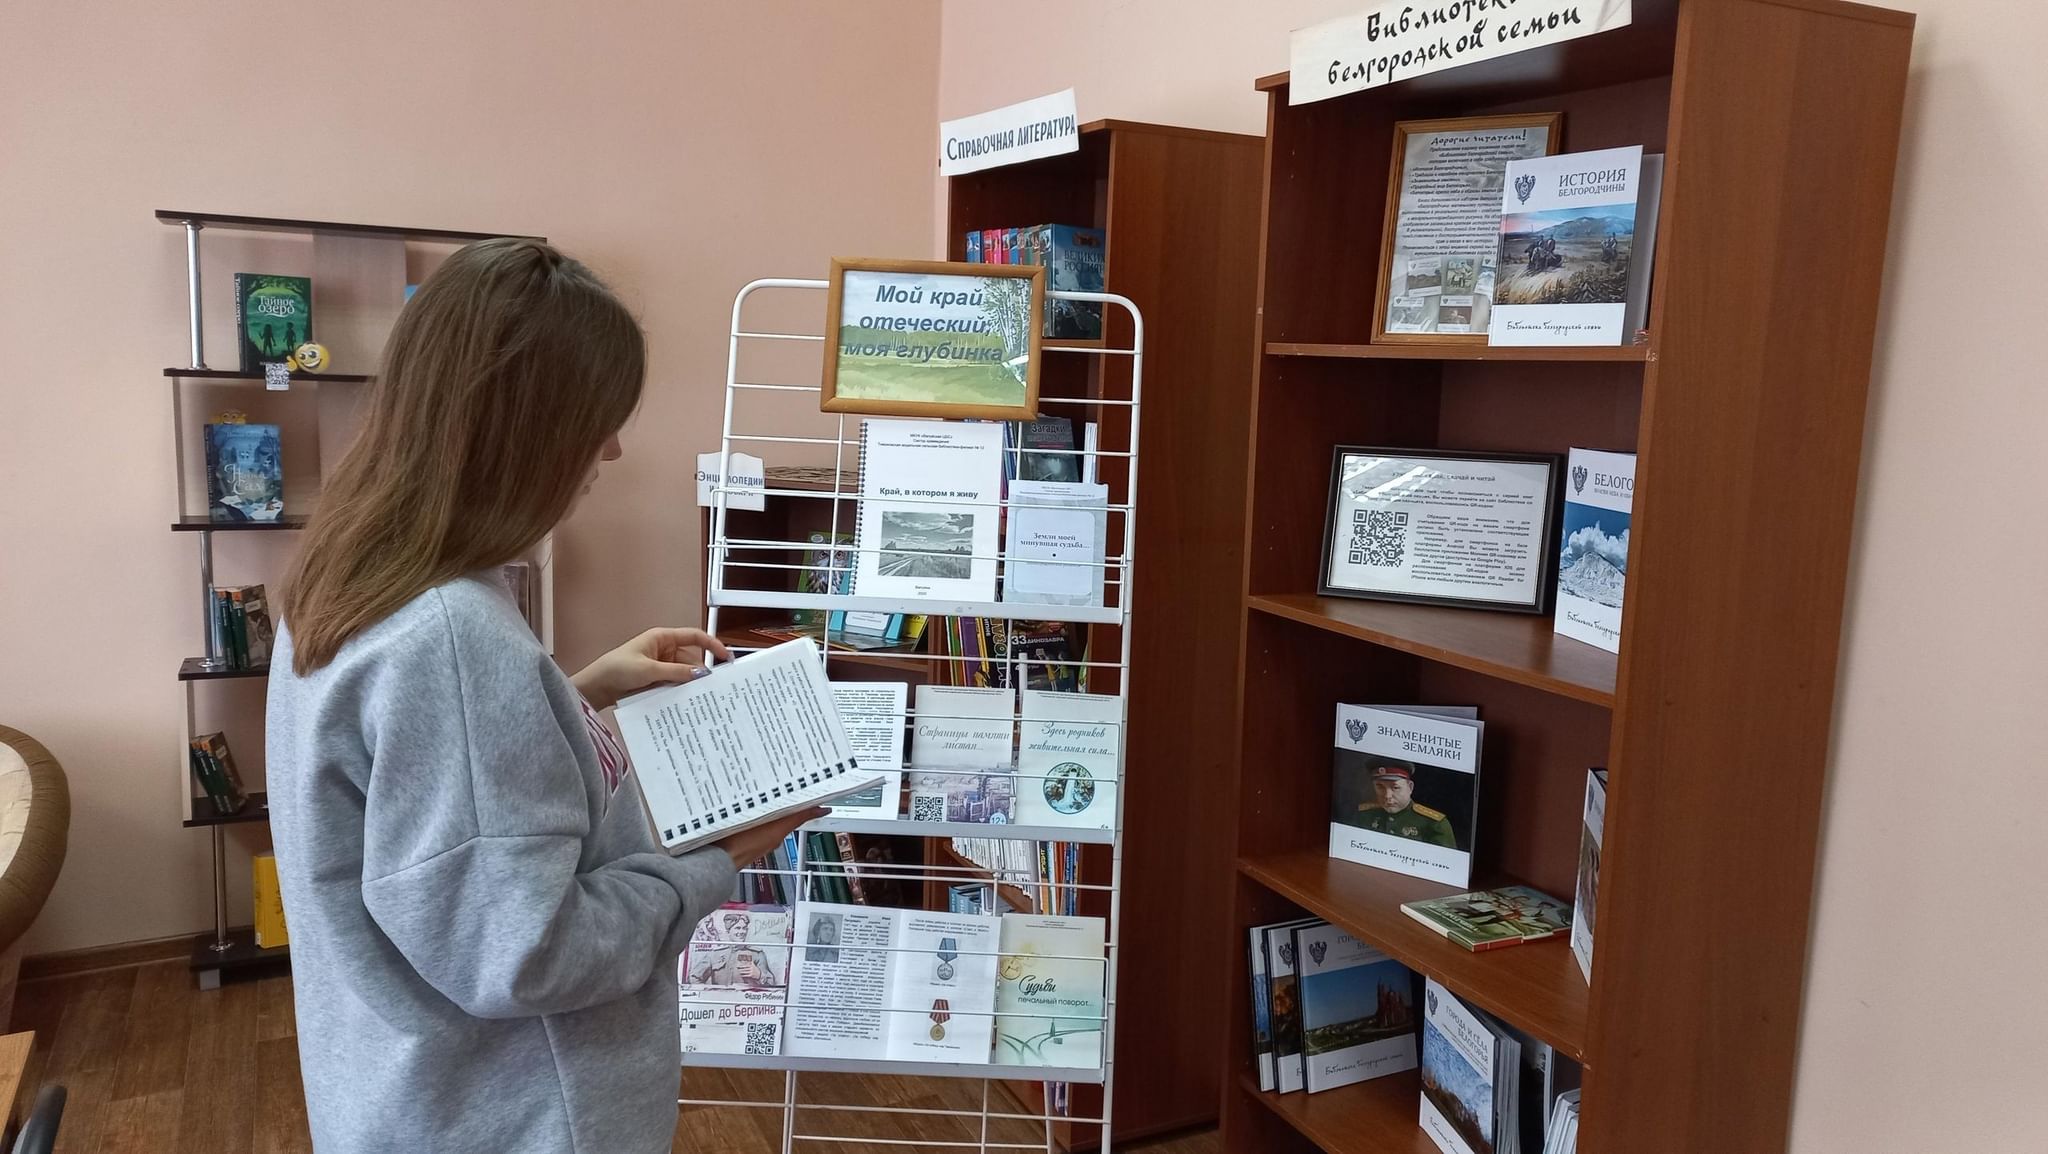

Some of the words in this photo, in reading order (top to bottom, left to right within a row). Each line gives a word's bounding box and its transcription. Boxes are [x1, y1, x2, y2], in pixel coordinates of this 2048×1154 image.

[1367, 0, 1515, 42] Библиотек
[1328, 18, 1488, 84] белгородской
[1497, 6, 1581, 42] семьи
[1017, 114, 1075, 146] ЛИТЕРАТУРА
[1559, 169, 1626, 187] ИСТОРИЯ
[1558, 183, 1626, 197] БЕЛГОРОДЧИНЫ
[259, 295, 295, 306] Тайное
[876, 285, 923, 304] Мой
[258, 303, 295, 314] озеро
[860, 315, 991, 336] отеческий,
[844, 342, 889, 357] моя
[896, 340, 1003, 363] глубинка
[1032, 423, 1065, 434] Загадки
[1594, 473, 1634, 492] БЕЛОГО
[880, 487, 902, 496] Край,
[912, 490, 947, 498] котором
[956, 491, 978, 499] живу
[1011, 636, 1027, 645] 33
[918, 725, 968, 741] Страницы
[972, 731, 1010, 740] памяти
[1041, 722, 1066, 737] Здесь
[1067, 727, 1106, 739] родников
[1377, 725, 1462, 750] ЗНАМЕНИТЫЕ
[1402, 742, 1461, 760] ЗЕМЛЯКИ
[991, 814, 1006, 824] 12+
[1018, 997, 1057, 1005] печальный
[681, 1008, 714, 1022] Дошел
[718, 1008, 731, 1019] до
[1446, 1005, 1467, 1031] ГОРОДА
